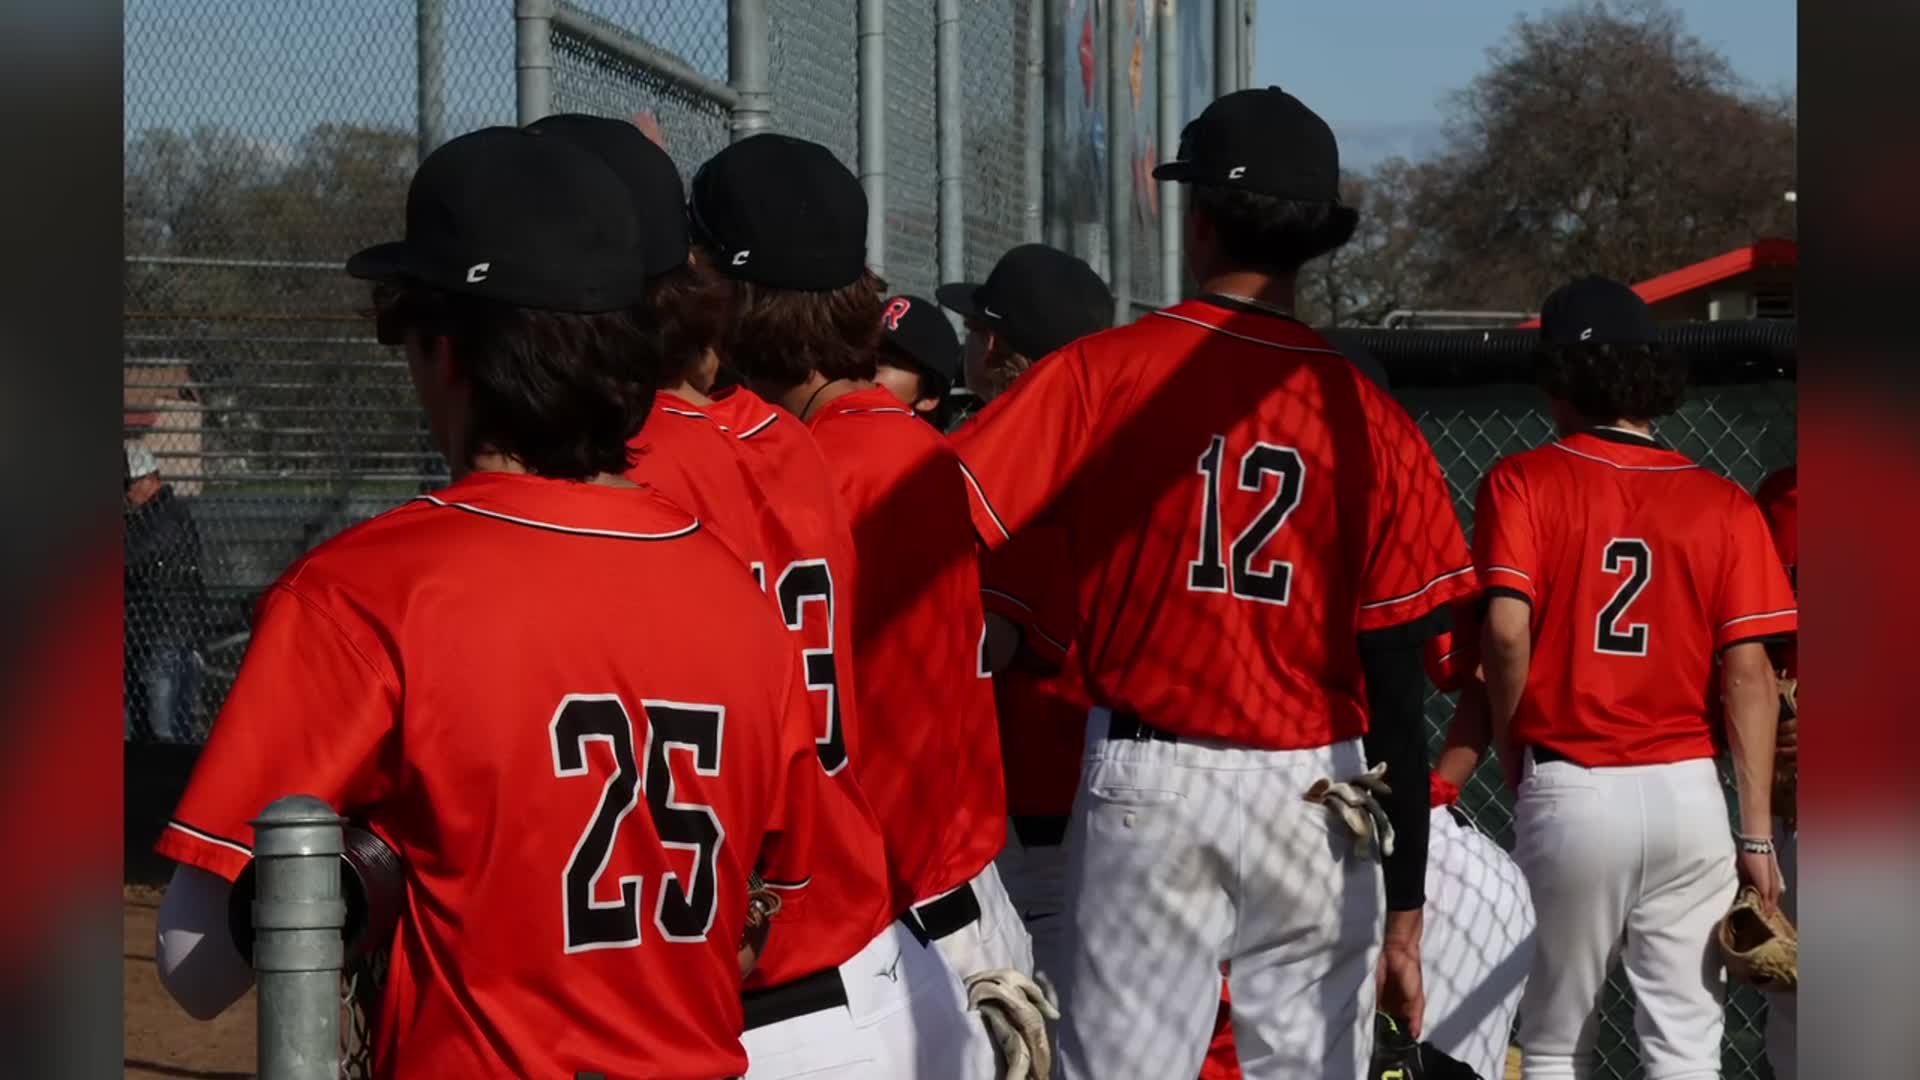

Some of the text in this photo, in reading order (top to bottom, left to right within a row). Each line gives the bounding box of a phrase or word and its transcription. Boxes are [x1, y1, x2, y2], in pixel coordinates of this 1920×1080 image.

[882, 296, 911, 331] R
[1187, 434, 1306, 606] 12
[1594, 537, 1653, 657] 2
[750, 558, 849, 777] 3
[549, 692, 726, 953] 25
